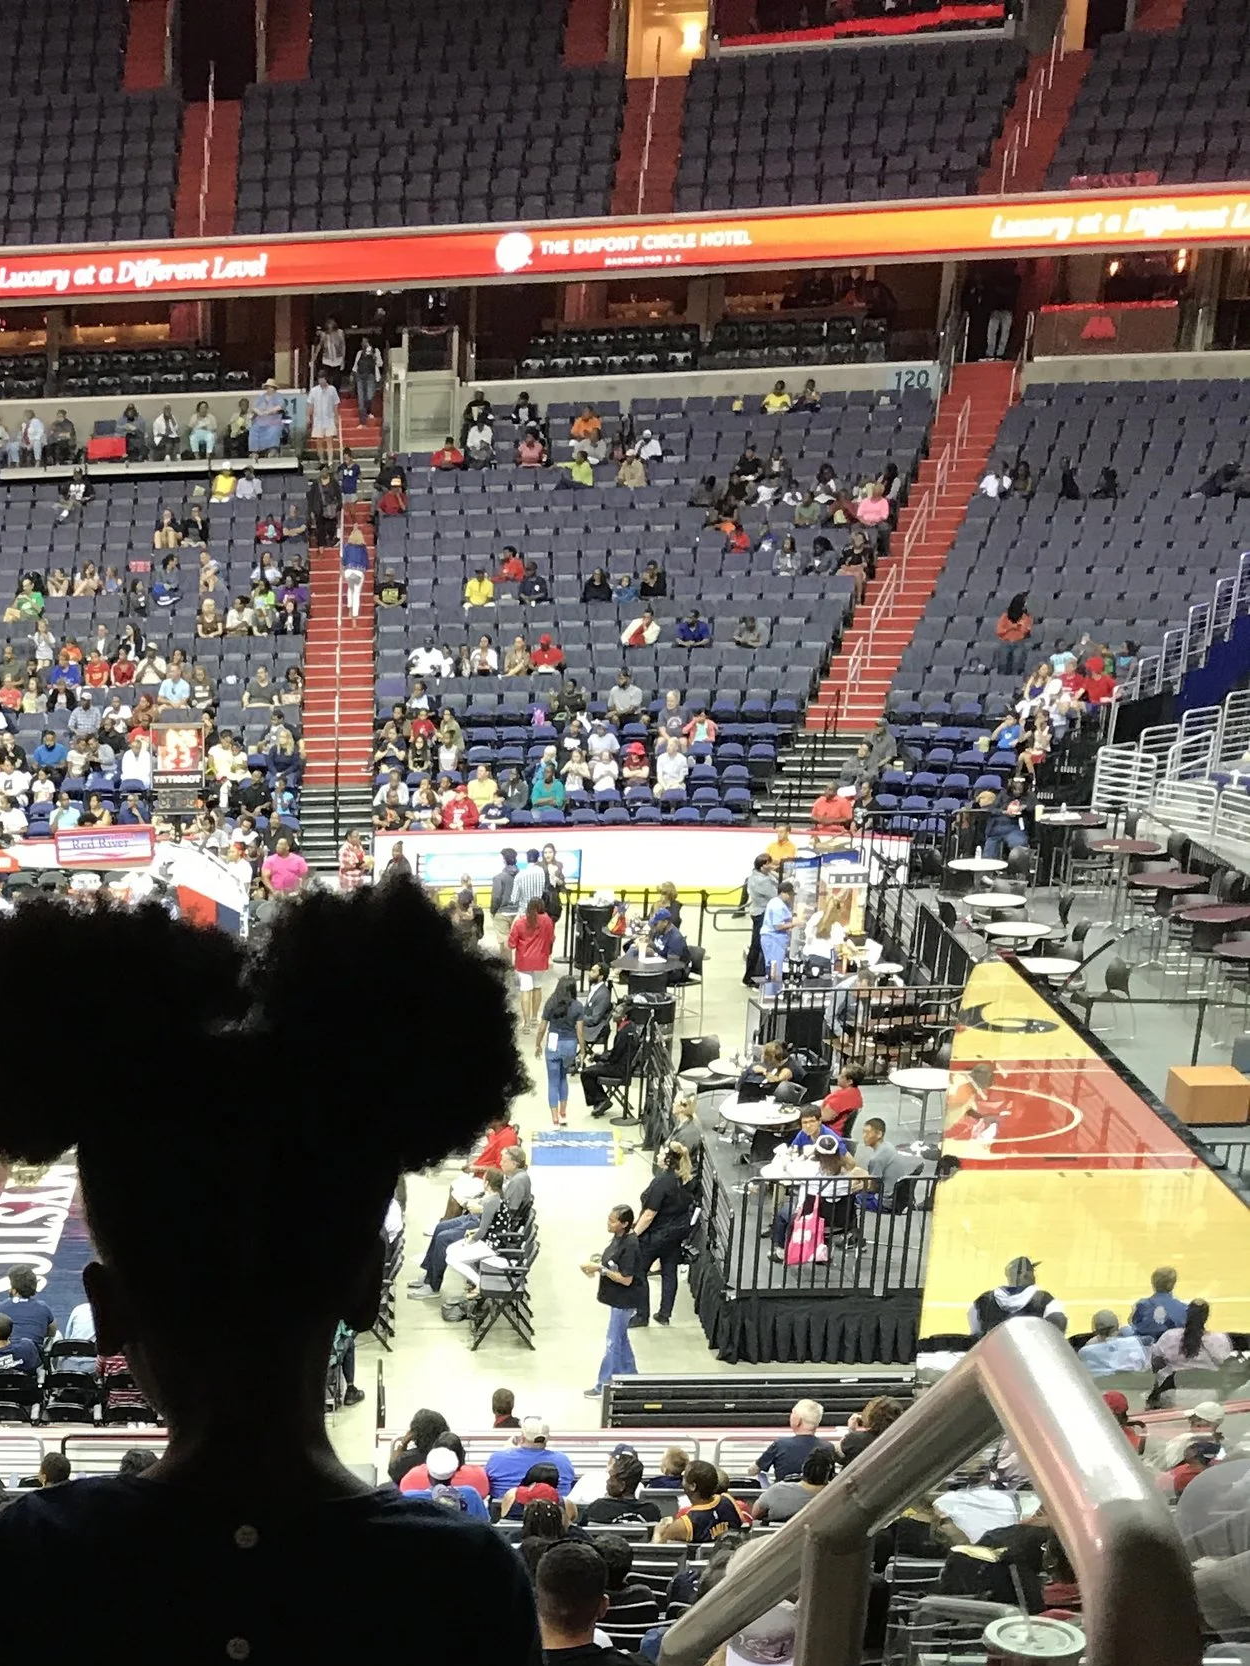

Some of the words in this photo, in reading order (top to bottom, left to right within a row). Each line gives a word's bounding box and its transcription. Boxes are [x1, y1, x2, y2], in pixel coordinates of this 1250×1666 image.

[540, 240, 569, 255] THE
[574, 236, 639, 254] DUPONT
[642, 233, 697, 250] CIRCLE
[701, 230, 753, 247] HOTEL
[73, 264, 97, 285] at
[98, 267, 114, 285] a
[116, 258, 209, 288] Different
[211, 253, 268, 279] Level
[895, 369, 930, 390] 120
[72, 837, 95, 850] Red
[99, 836, 129, 848] River
